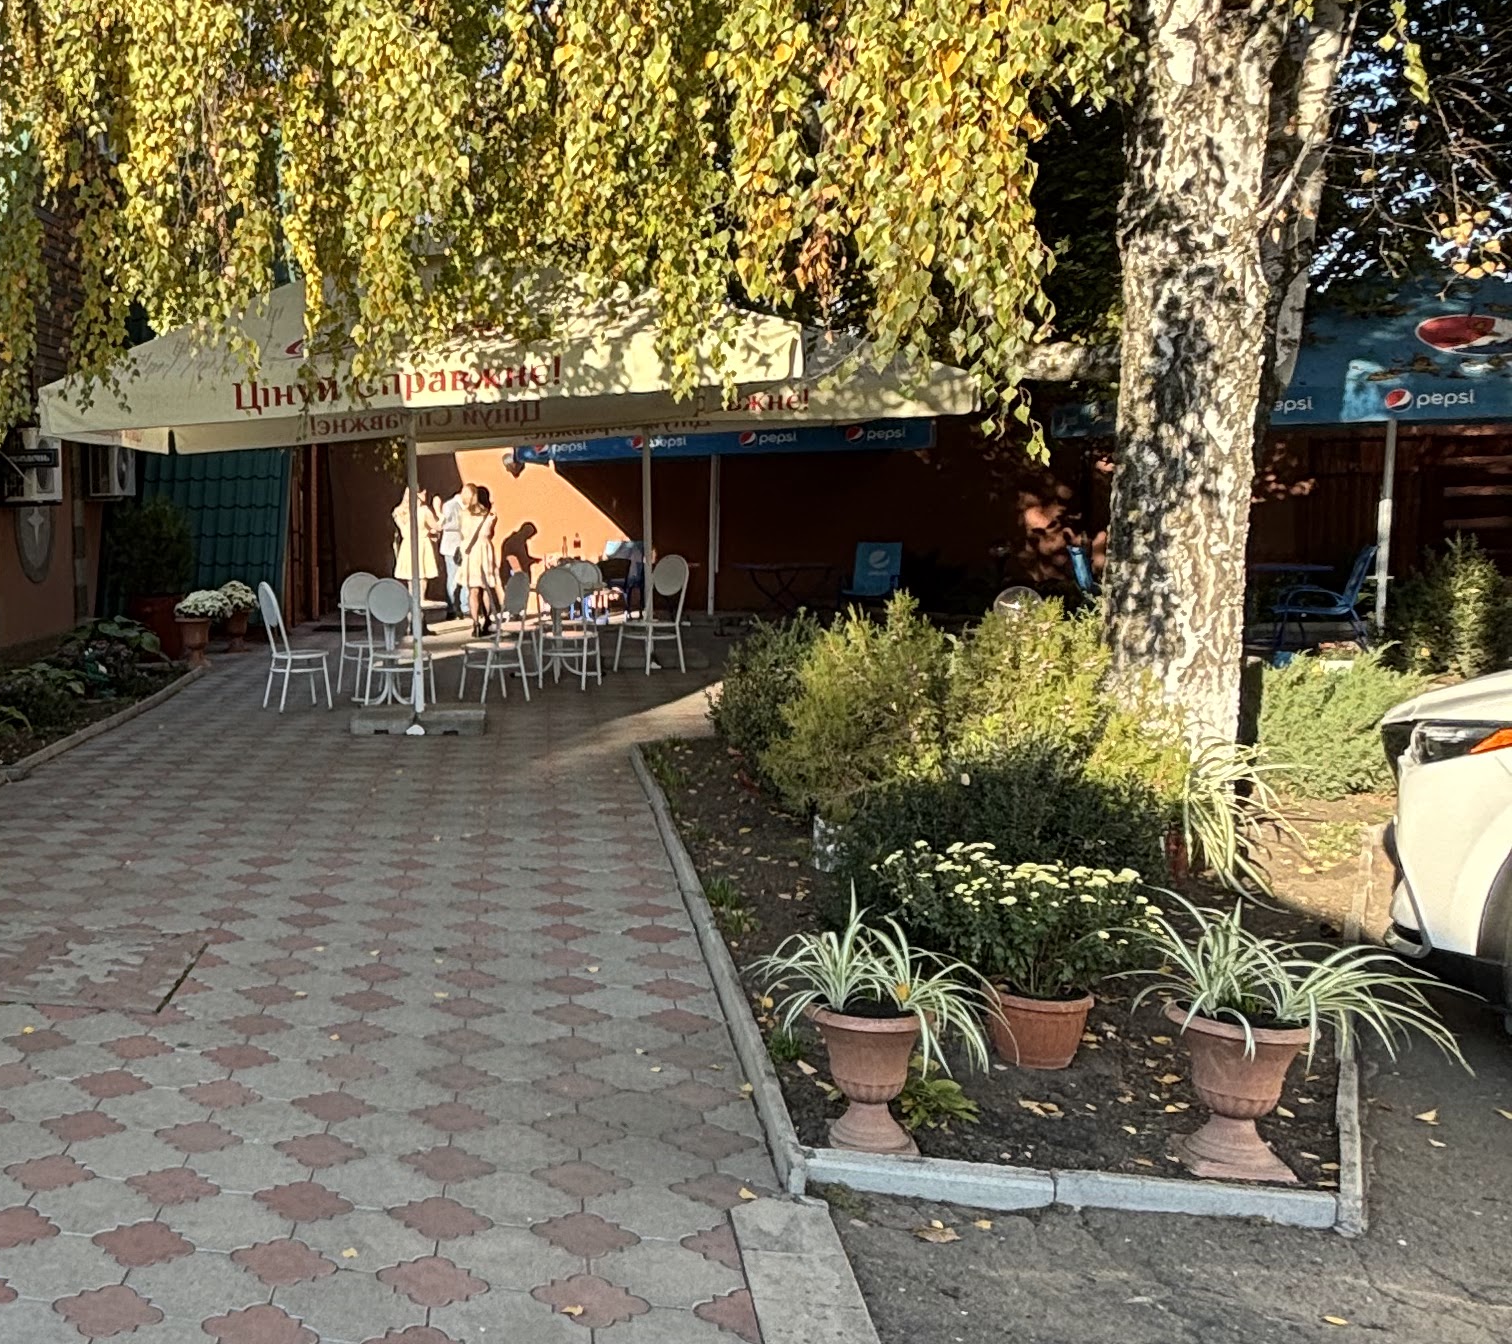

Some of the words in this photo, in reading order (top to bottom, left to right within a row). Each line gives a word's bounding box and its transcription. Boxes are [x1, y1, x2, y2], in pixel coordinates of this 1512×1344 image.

[232, 374, 339, 415] Цінуй
[1416, 389, 1476, 410] pepsi
[1273, 395, 1314, 415] epsi
[758, 429, 798, 446] pepsi
[866, 426, 907, 442] pepsi
